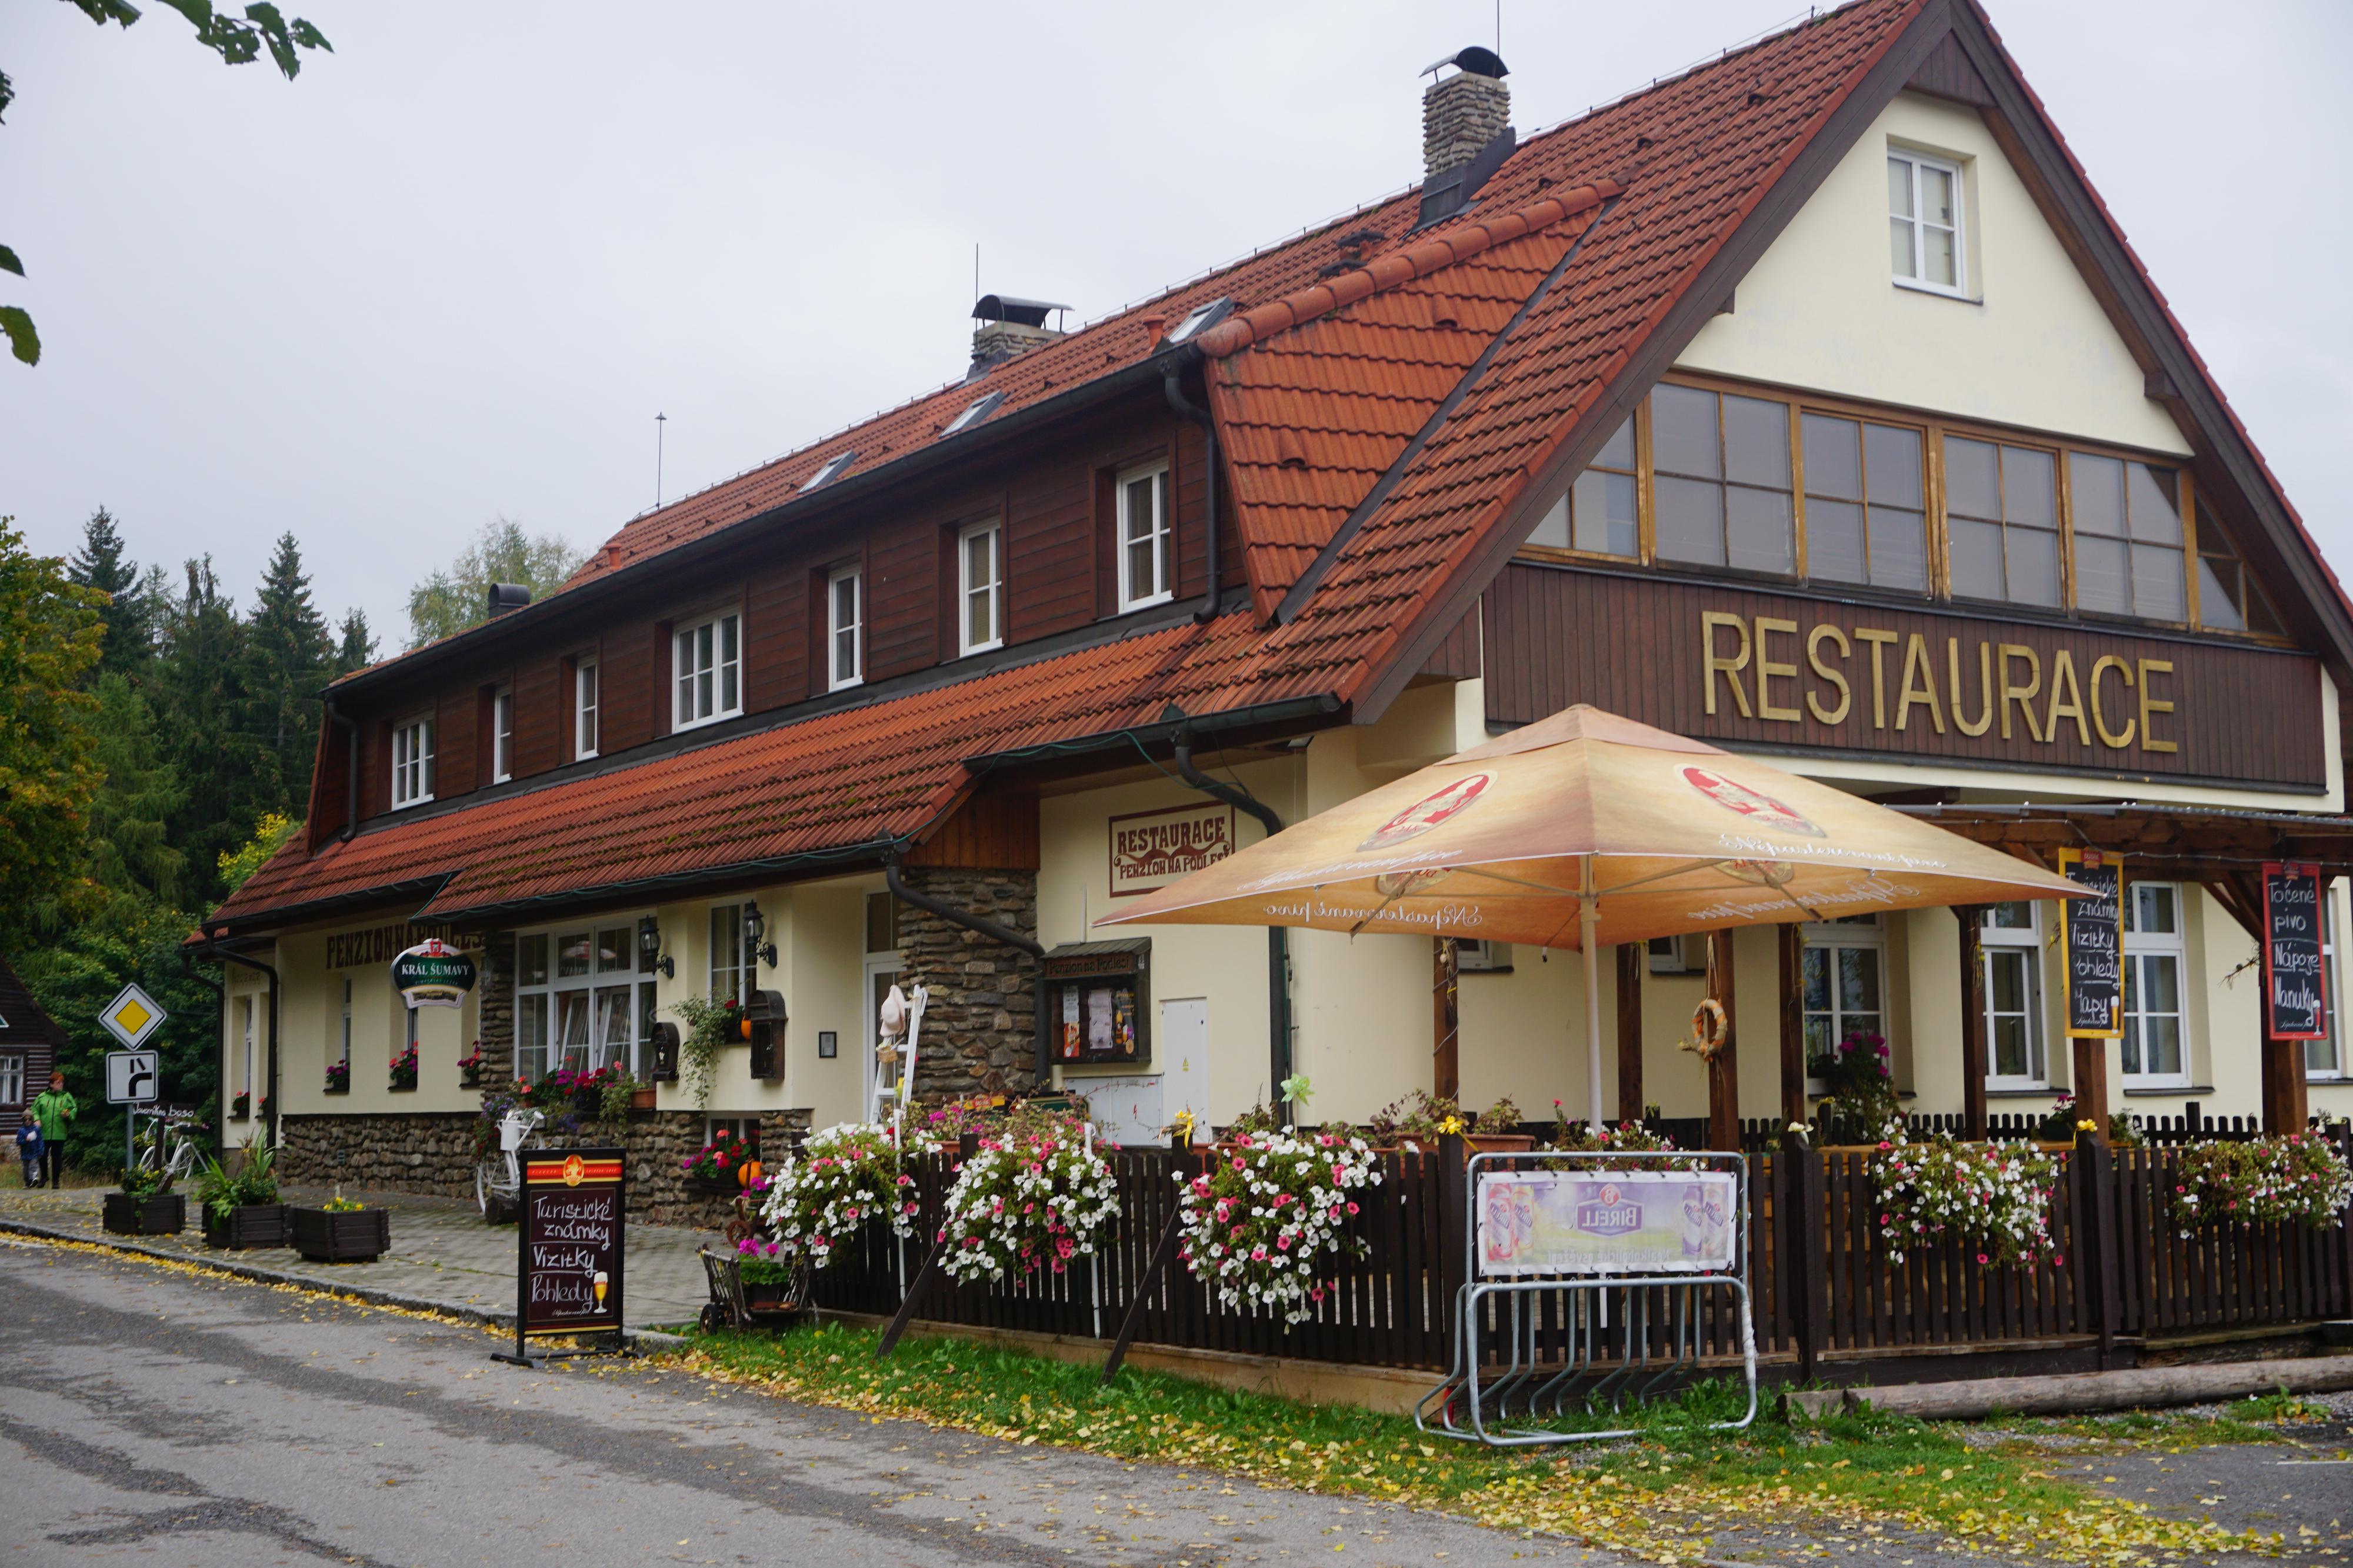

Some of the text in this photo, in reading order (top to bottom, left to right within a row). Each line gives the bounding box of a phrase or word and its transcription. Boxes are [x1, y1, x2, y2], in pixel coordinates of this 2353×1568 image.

[1701, 610, 2178, 753] RESTAURACE
[1117, 816, 1225, 855] RESTAURACE
[1119, 860, 1166, 880] PENZION
[1167, 858, 1182, 874] NA
[2268, 880, 2317, 904] Točené
[2275, 908, 2307, 933] pivo
[326, 926, 394, 970] PENZION
[402, 963, 470, 976] KRÁL ŠUMAVY
[2274, 976, 2315, 1027] Nanuky
[168, 1104, 194, 1117] boso
[533, 1196, 614, 1222] Turistické
[544, 1219, 611, 1251] známky
[534, 1245, 598, 1279] Vizitky
[531, 1274, 594, 1312] Pohledy
